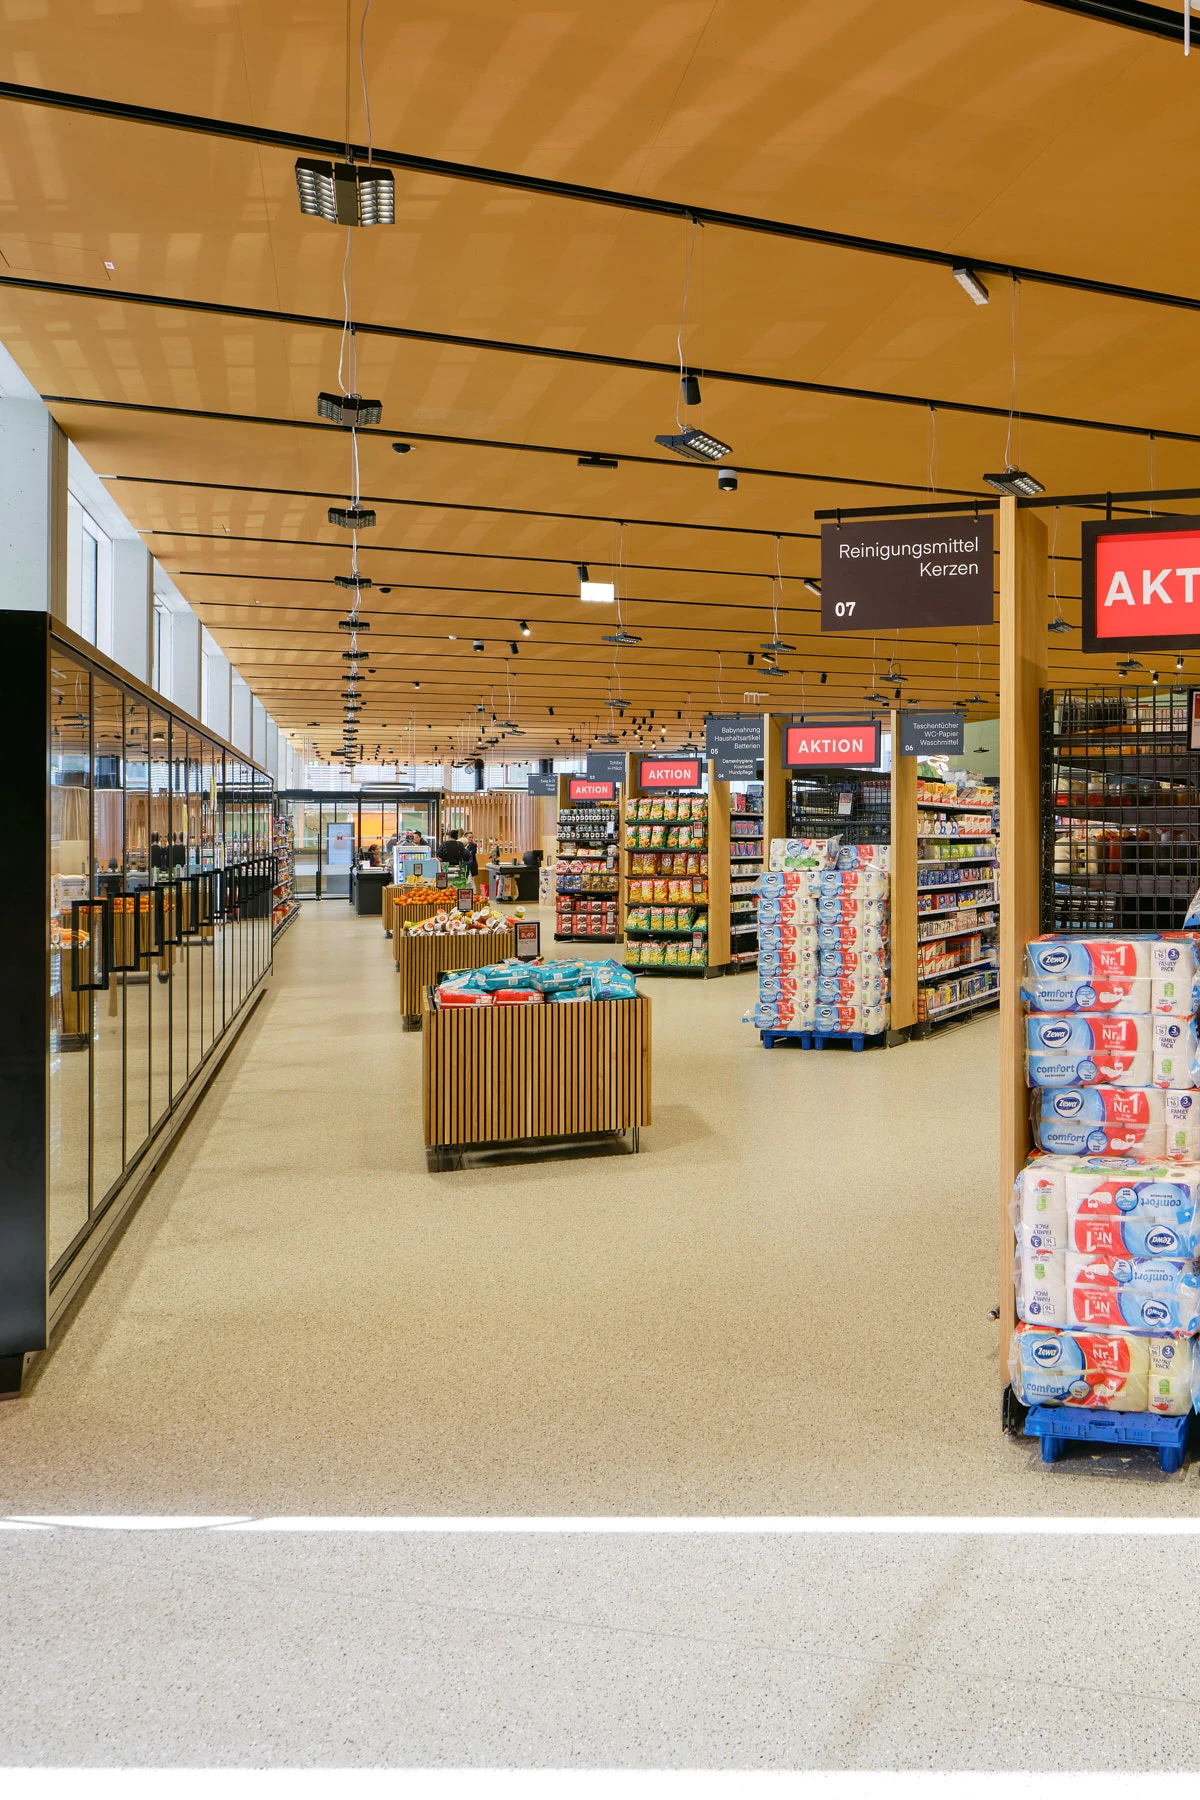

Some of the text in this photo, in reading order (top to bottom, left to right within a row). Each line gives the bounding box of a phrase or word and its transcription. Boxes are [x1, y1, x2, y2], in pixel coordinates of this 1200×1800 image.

[839, 536, 979, 561] Reinigungsmittel
[920, 562, 979, 577] Kerzen
[834, 601, 856, 617] 07
[721, 726, 761, 735] Babynahrung
[913, 722, 959, 730] Taschentücher
[925, 730, 959, 738] WC-Papier
[797, 738, 864, 754] AKTION
[919, 738, 959, 746] Waschmittel
[648, 769, 691, 779] AKTION
[575, 786, 608, 794] AKTION
[1045, 955, 1065, 963] Zewa
[1047, 1029, 1066, 1038] Zewa
[1036, 1065, 1075, 1074] comfort
[1059, 1098, 1078, 1107] Zewa
[1047, 1133, 1085, 1142] comfort
[1140, 1197, 1181, 1206] comfort
[1153, 1236, 1173, 1246] Zewa
[1133, 1272, 1174, 1282] comfort
[1147, 1308, 1165, 1319] Zewa
[1037, 1348, 1056, 1356] Zewa
[1026, 1382, 1066, 1393] comfort
